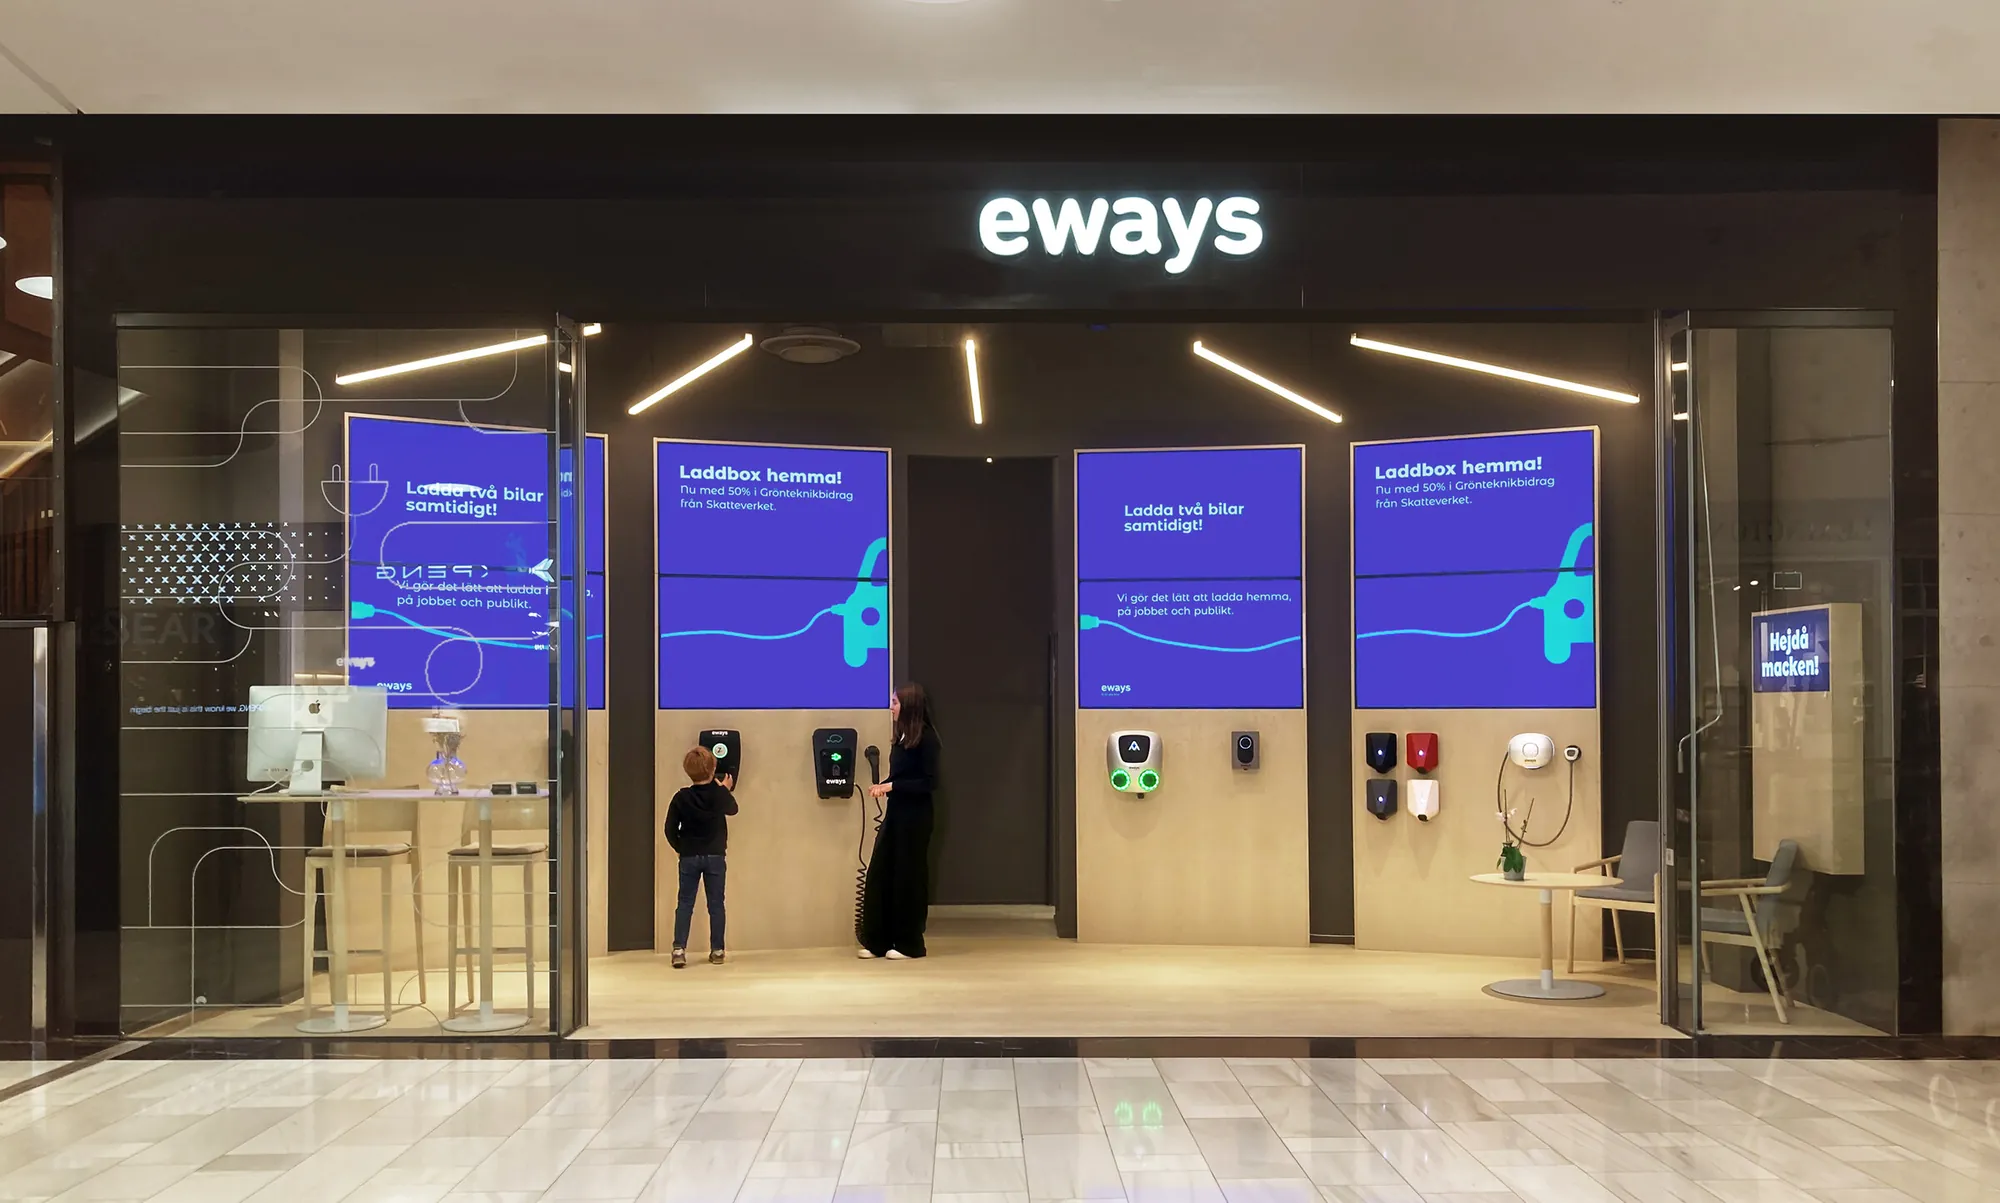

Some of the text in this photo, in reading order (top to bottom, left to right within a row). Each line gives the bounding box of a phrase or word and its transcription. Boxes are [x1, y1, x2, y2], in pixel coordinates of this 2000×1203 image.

[979, 196, 1263, 274] eways
[679, 464, 842, 485] Laddbox hemma!
[1375, 456, 1543, 480] Laddbox hemma!
[406, 480, 465, 498] Ladda
[469, 483, 498, 501] två
[503, 486, 545, 503] bilar
[680, 484, 697, 495] Nu
[699, 485, 725, 496] med
[727, 486, 752, 497] 50%
[759, 487, 854, 502] Grönteknikbidrag
[1375, 485, 1391, 495] Nu
[1394, 483, 1420, 494] med
[1422, 482, 1447, 493] 50%
[1455, 476, 1555, 491] Grönteknikbidrag
[405, 499, 498, 519] samtidigt!
[680, 497, 777, 511] från Skatteverket.
[1124, 501, 1245, 517] Ladda två bilar
[1375, 495, 1473, 509] från Skatteverket.
[1123, 517, 1203, 534] samtidigt!
[412, 580, 434, 592] gör
[437, 580, 458, 591] det
[461, 581, 483, 592] lätt
[486, 582, 502, 593] att
[506, 584, 542, 594] ladda
[396, 593, 532, 610] på jobbet och publikt.
[1116, 591, 1292, 605] Vi gör det lätt att ladda hemma,
[1117, 605, 1234, 618] på jobbet och publikt.
[1769, 625, 1809, 656] Hejdå
[1761, 655, 1820, 678] macken!
[1100, 684, 1132, 693] eways
